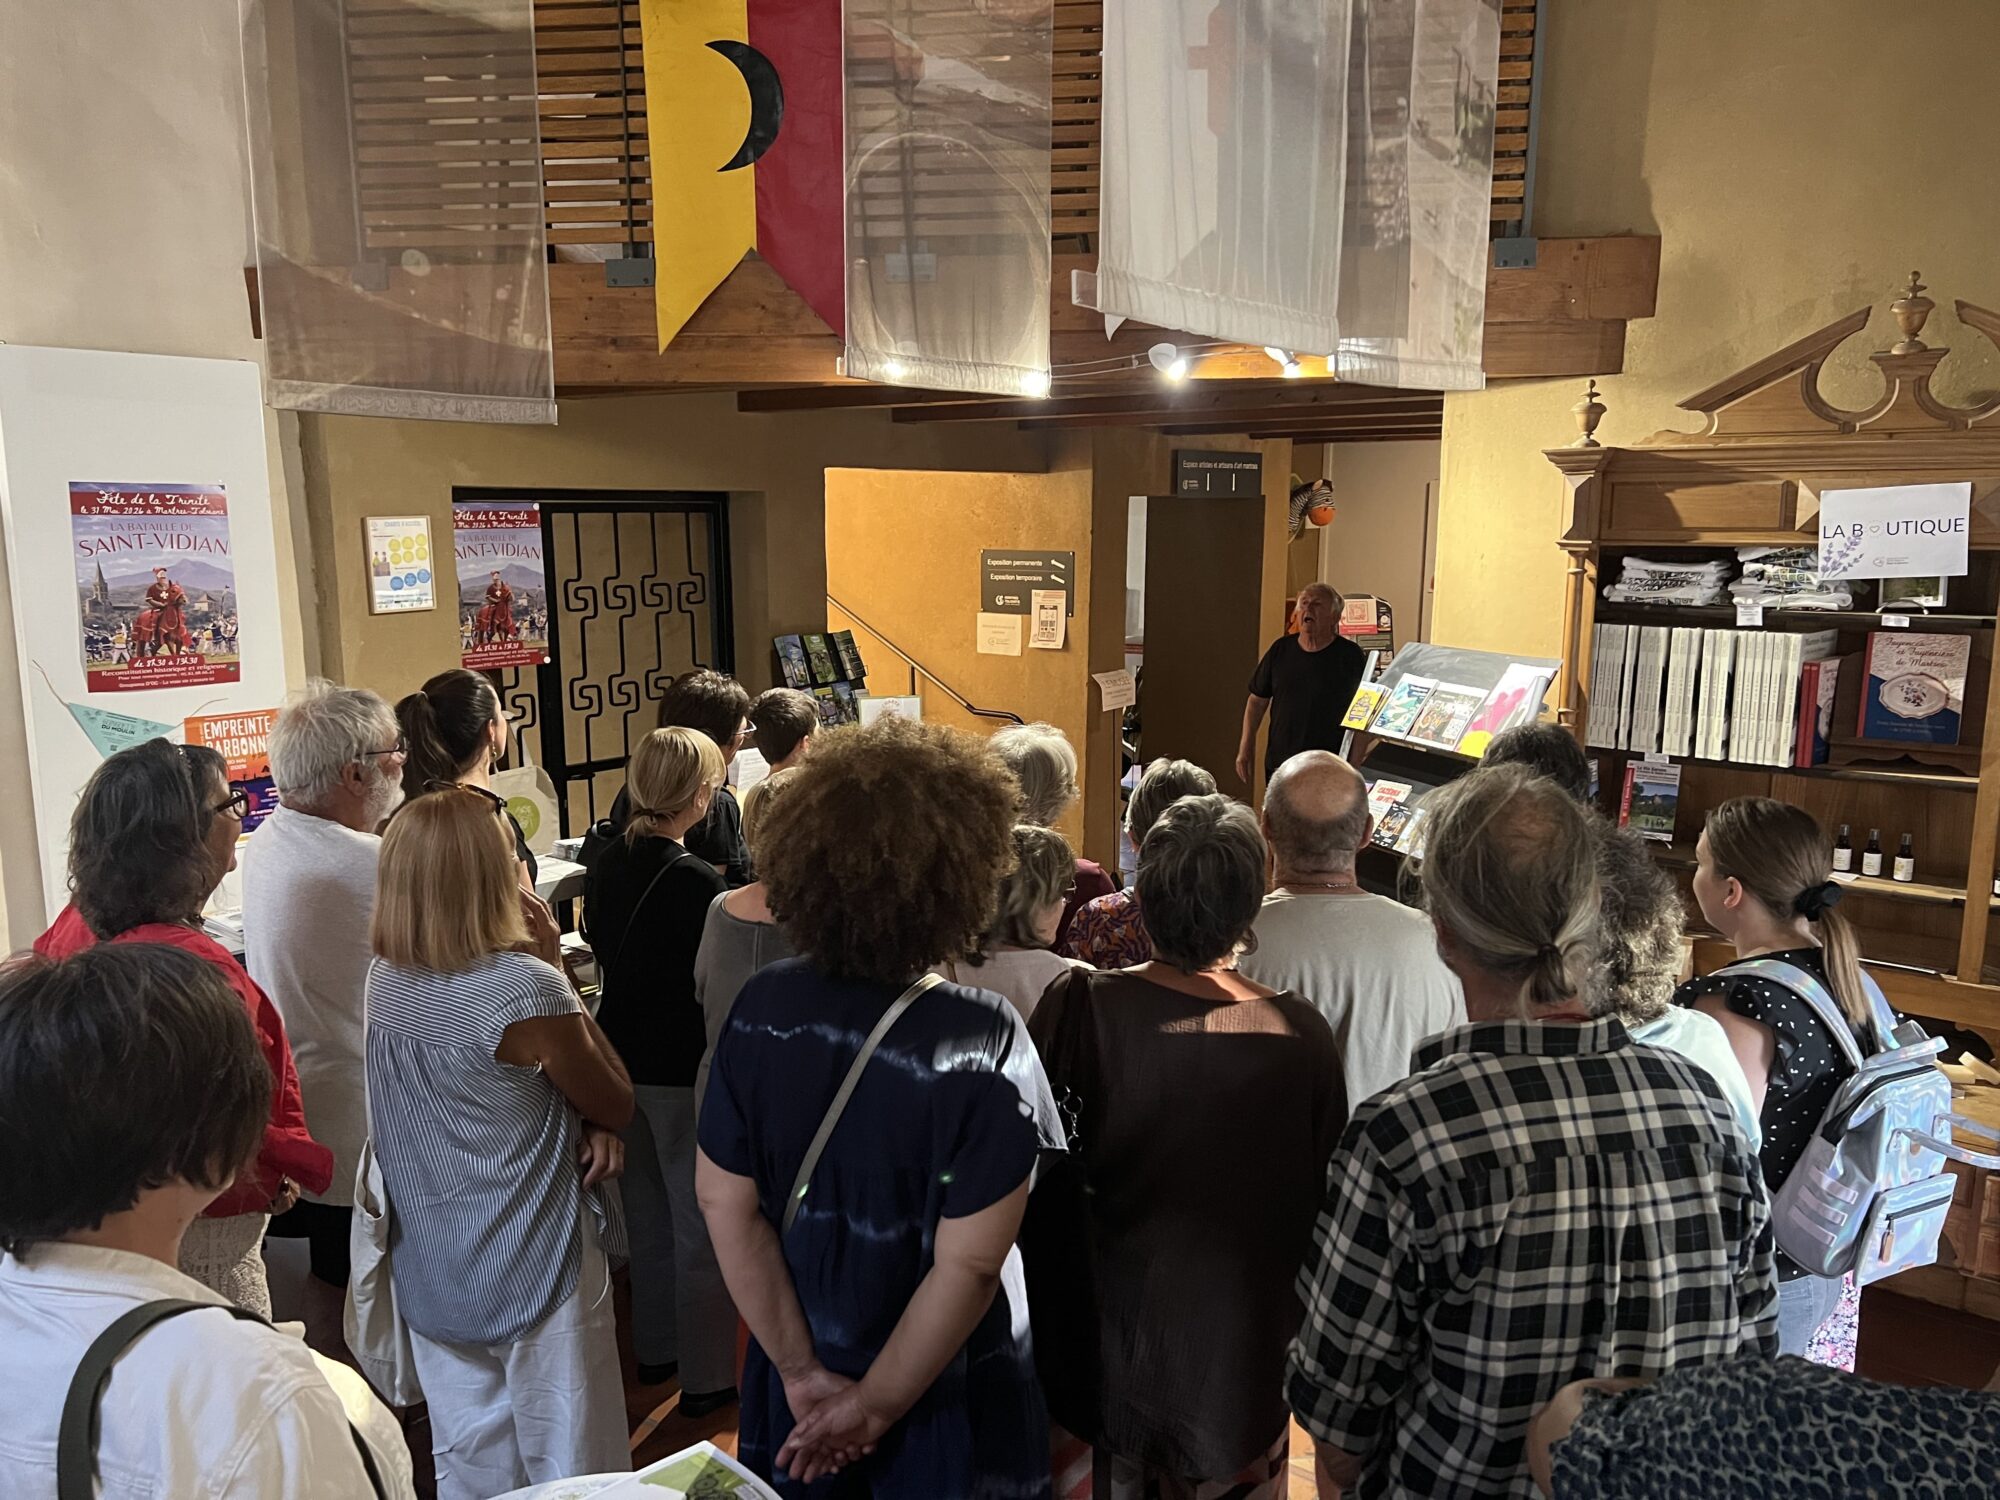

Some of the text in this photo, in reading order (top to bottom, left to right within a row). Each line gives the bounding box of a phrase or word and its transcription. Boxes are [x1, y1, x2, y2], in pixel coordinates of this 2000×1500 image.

[96, 490, 210, 504] Fête de la Trinité
[102, 506, 119, 514] Mai
[454, 510, 474, 520] Fête
[477, 512, 487, 520] de
[489, 512, 496, 520] la
[128, 523, 176, 531] BATAILLE
[181, 523, 192, 531] DE
[1824, 525, 1845, 538] LA
[79, 533, 228, 557] SAINT-VIDIAN
[454, 543, 540, 560] AINT-VIDIAN
[134, 659, 144, 667] de
[146, 658, 165, 667] 8h30
[176, 657, 198, 665] 13h30
[102, 668, 153, 677] Reconstitution
[112, 726, 135, 735] MOULIN
[203, 716, 270, 740] EMPREINTE
[206, 736, 268, 758] ARBONN
